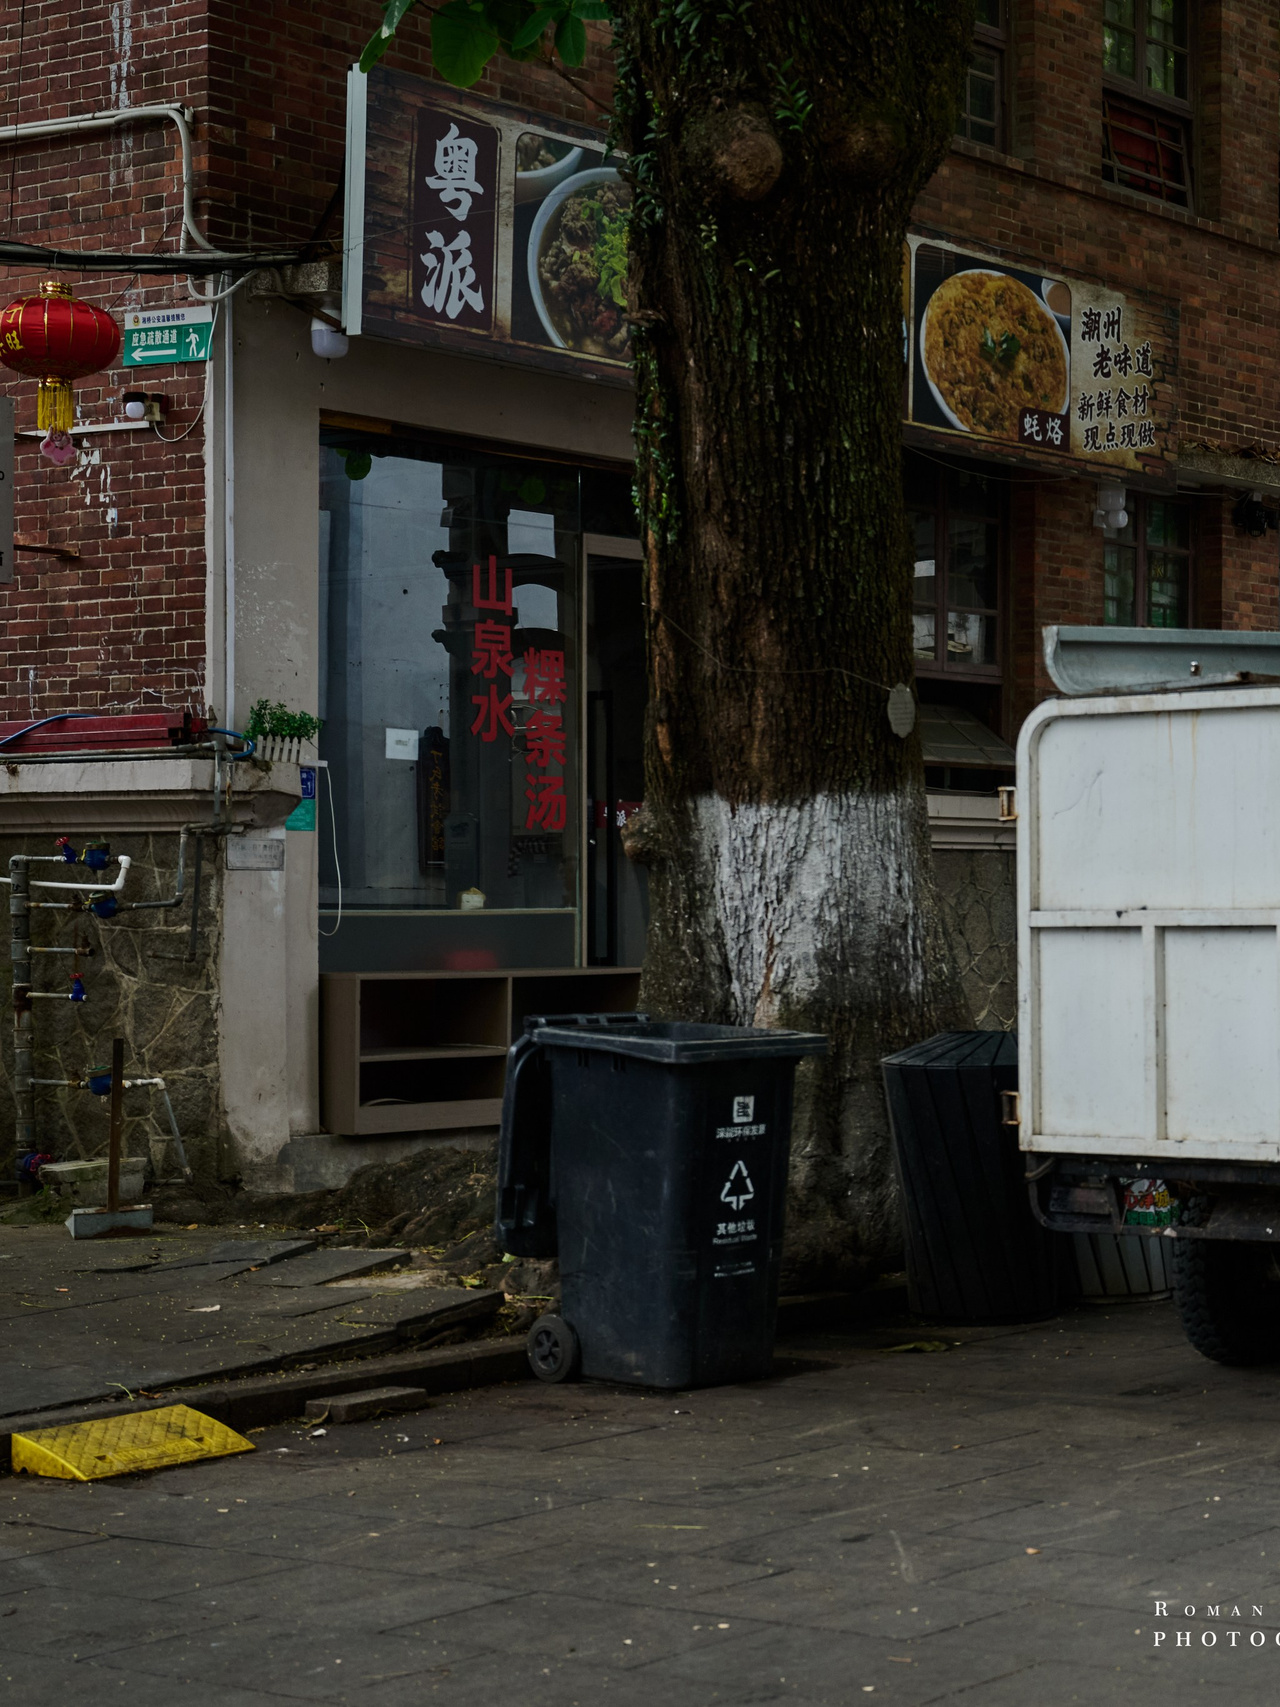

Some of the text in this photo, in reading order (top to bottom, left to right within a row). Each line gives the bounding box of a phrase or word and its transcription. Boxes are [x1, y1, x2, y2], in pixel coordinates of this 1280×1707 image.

[420, 122, 484, 319] 粤派
[131, 329, 178, 347] 应急疏散通道
[1081, 306, 1122, 343] 潮州
[1092, 342, 1154, 379] 老味道
[1077, 385, 1149, 422] 新鲜食材
[1023, 414, 1065, 446] 蚝烙
[1082, 421, 1155, 452] 现点现做
[470, 555, 516, 742] 山泉水
[523, 646, 567, 831] 粿条汤
